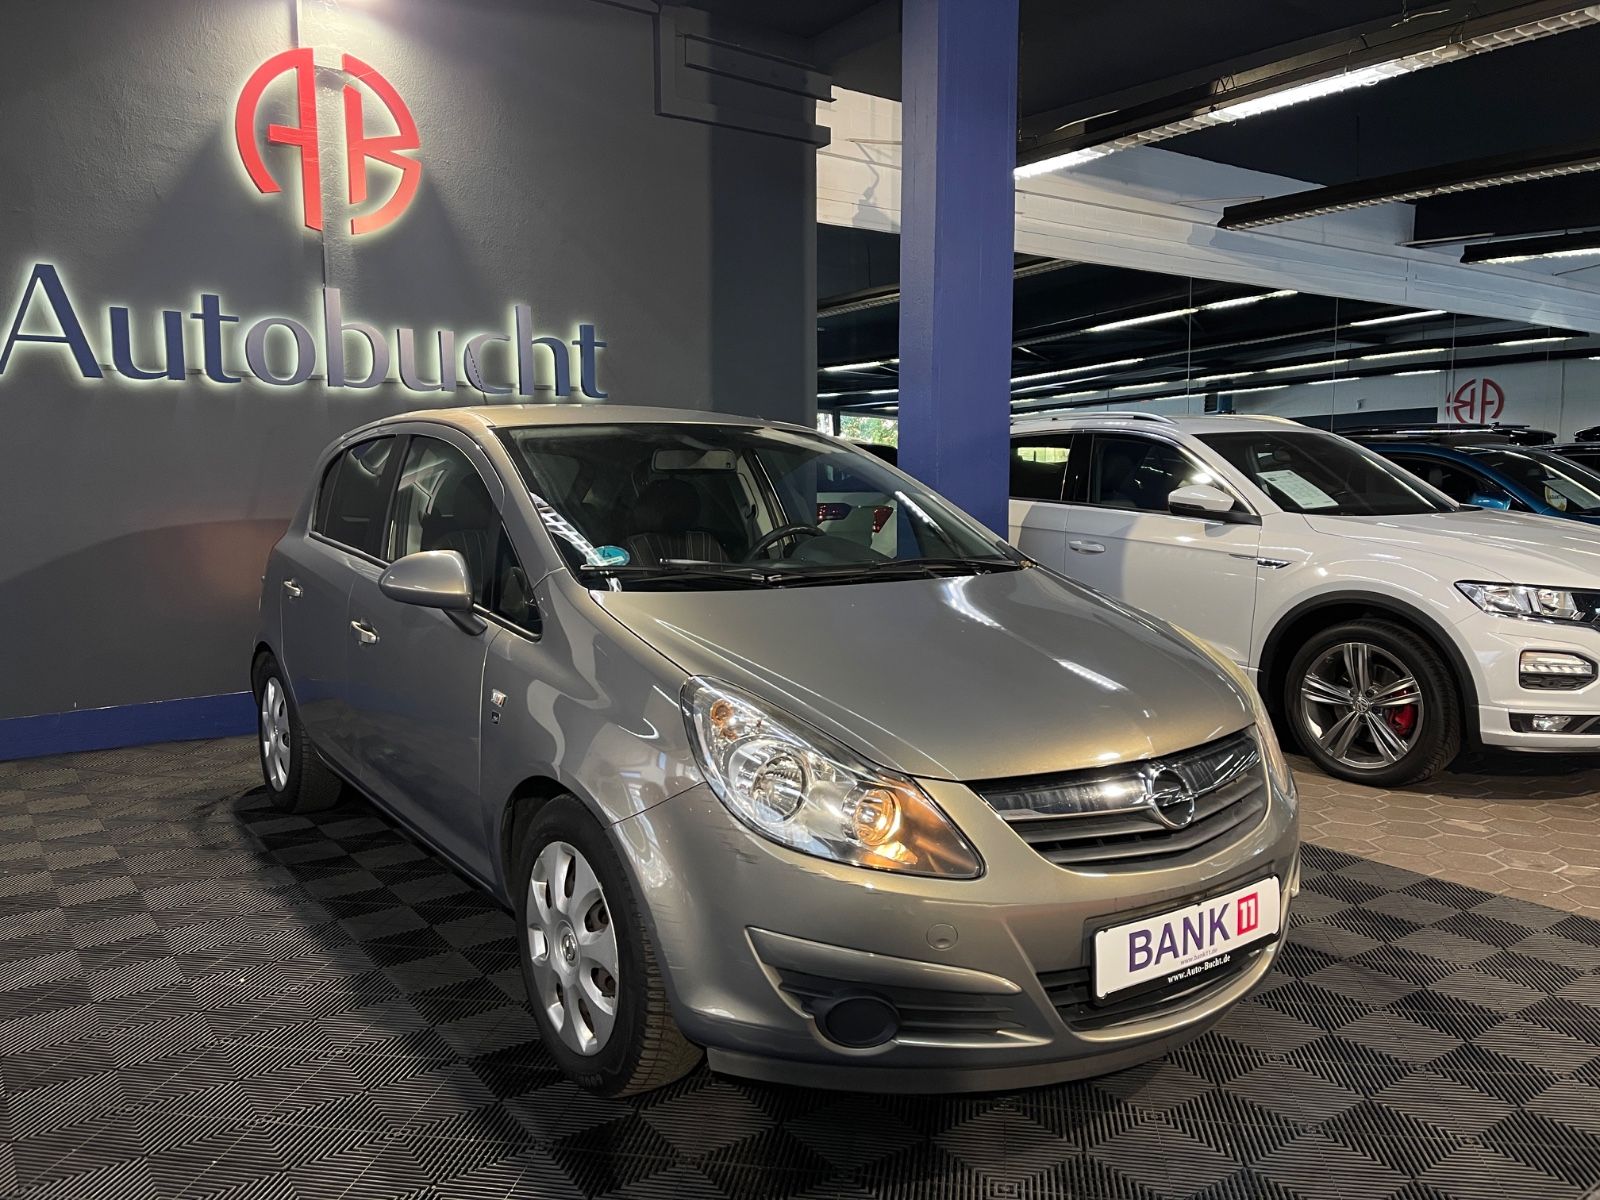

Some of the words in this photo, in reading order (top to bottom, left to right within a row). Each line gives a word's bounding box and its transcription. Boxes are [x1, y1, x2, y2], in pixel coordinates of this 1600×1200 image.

[0, 264, 608, 399] Autobucht
[1129, 903, 1231, 973] BANK
[1239, 897, 1257, 931] 11
[1167, 954, 1231, 984] www.Auto-Bucht.de
